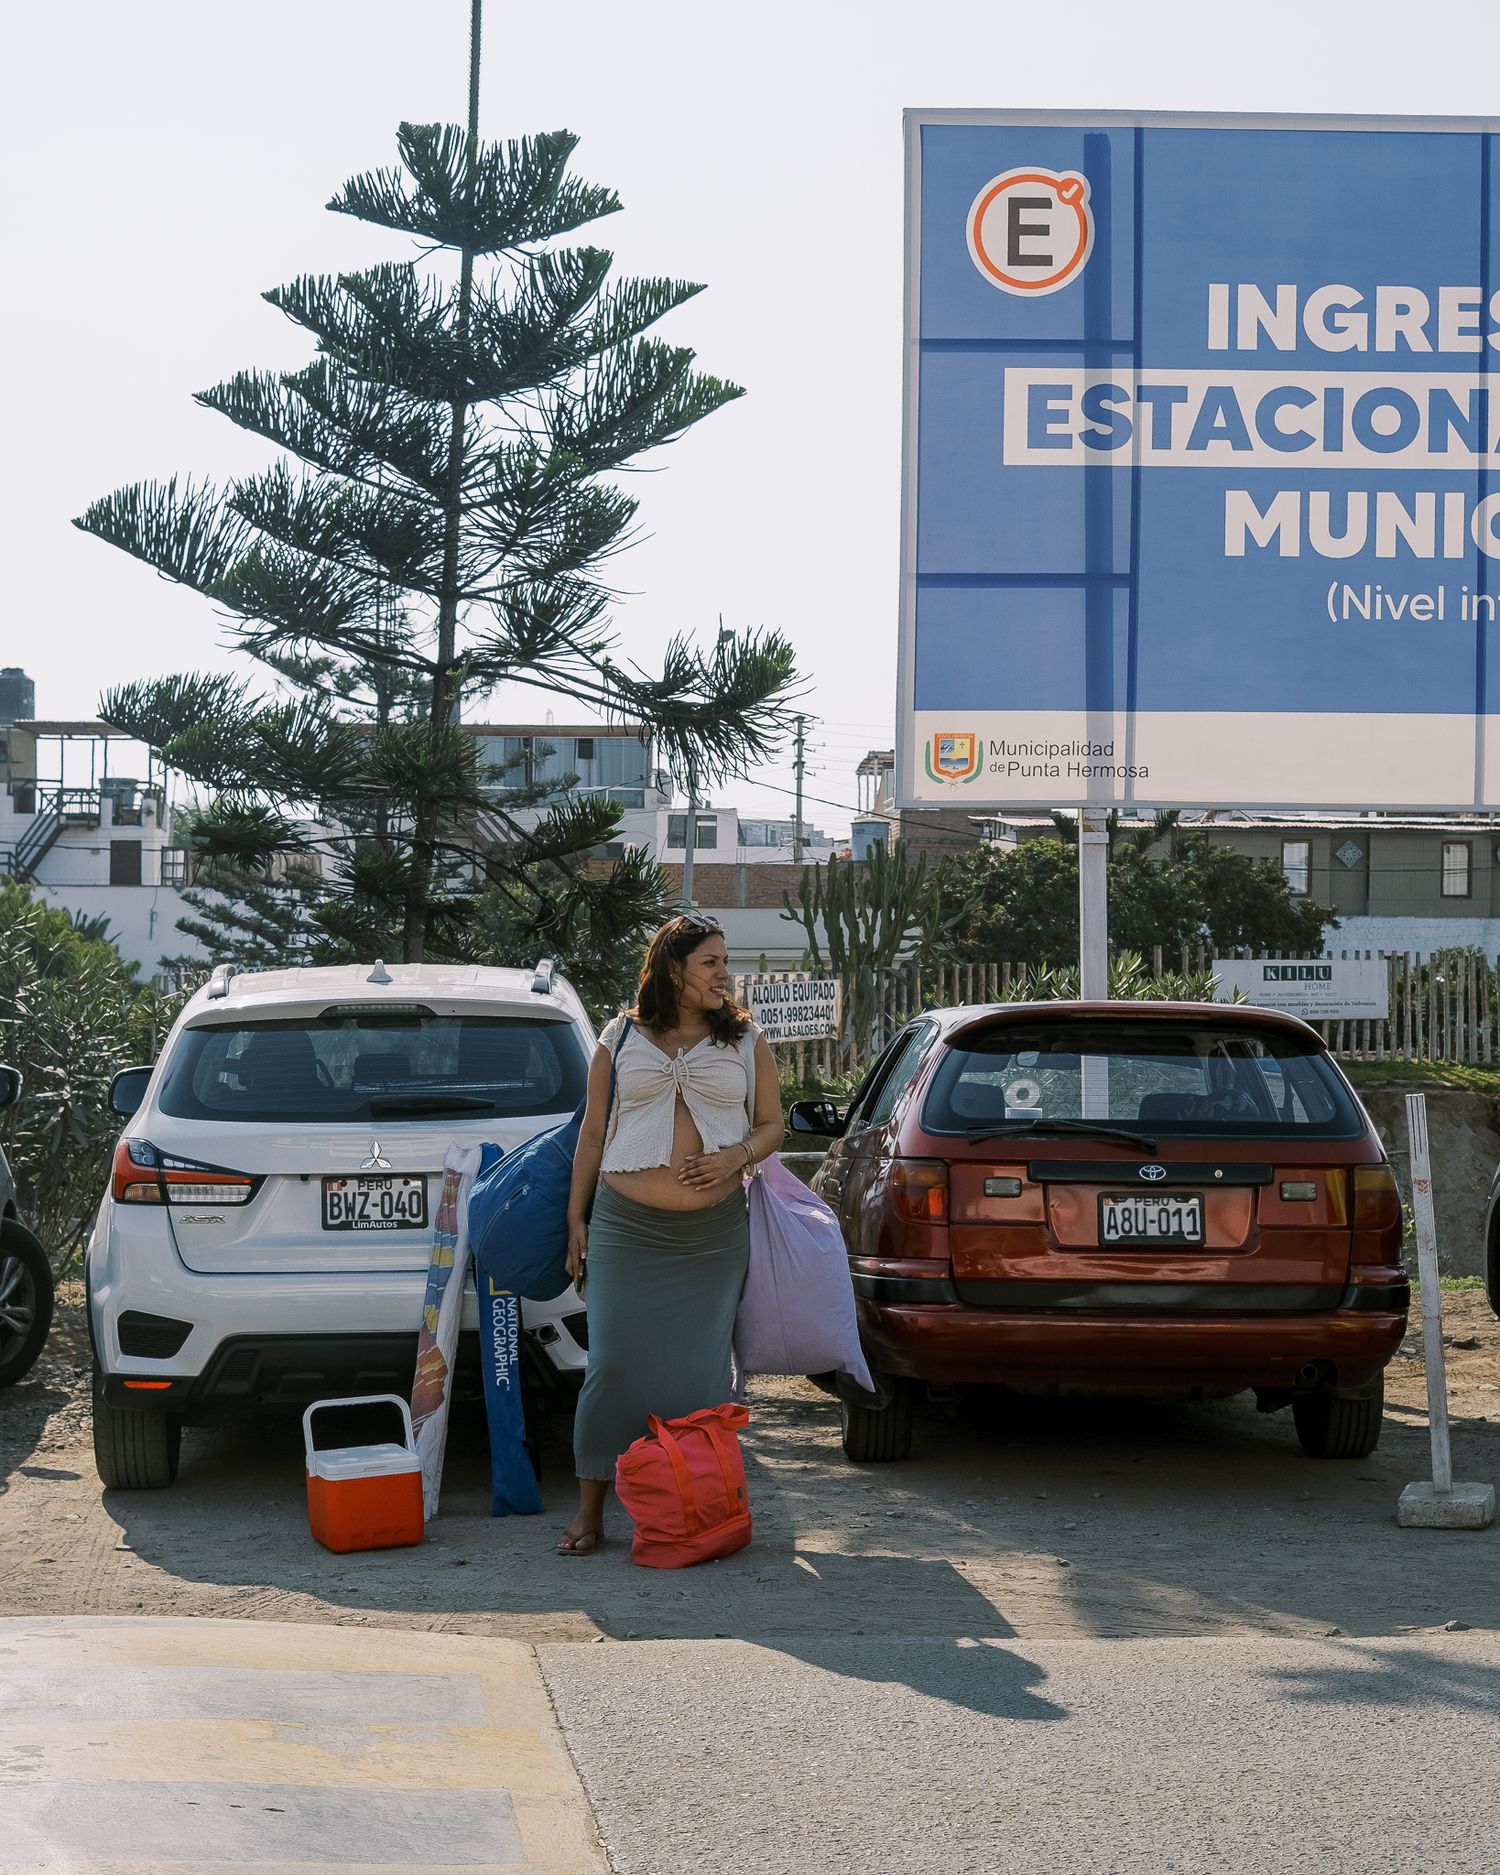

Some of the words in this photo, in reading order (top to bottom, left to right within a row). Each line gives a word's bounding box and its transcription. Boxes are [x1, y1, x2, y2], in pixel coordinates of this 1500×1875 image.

[1007, 196, 1053, 267] E
[1208, 283, 1500, 352] INGRE
[1027, 383, 1500, 453] ESTACION
[1327, 580, 1445, 624] (Nivel
[1461, 585, 1500, 622] in
[989, 739, 1114, 760] Municipalidad
[989, 761, 1006, 773] de
[1007, 761, 1060, 777] Punta
[1067, 761, 1149, 778] Hermosa
[1264, 966, 1331, 981] KILU
[1304, 982, 1332, 991] HOME
[752, 984, 790, 1005] ALQUILO
[792, 982, 835, 1002] EQUIPADO
[760, 1004, 835, 1025] 0051-998234401
[329, 1190, 422, 1220] BWZ-040
[352, 1220, 398, 1229] LimAutos
[1106, 1207, 1200, 1236] A8U-011
[492, 1298, 510, 1387] GEOGRAPHIC
[507, 1296, 519, 1366] NATIONAL
